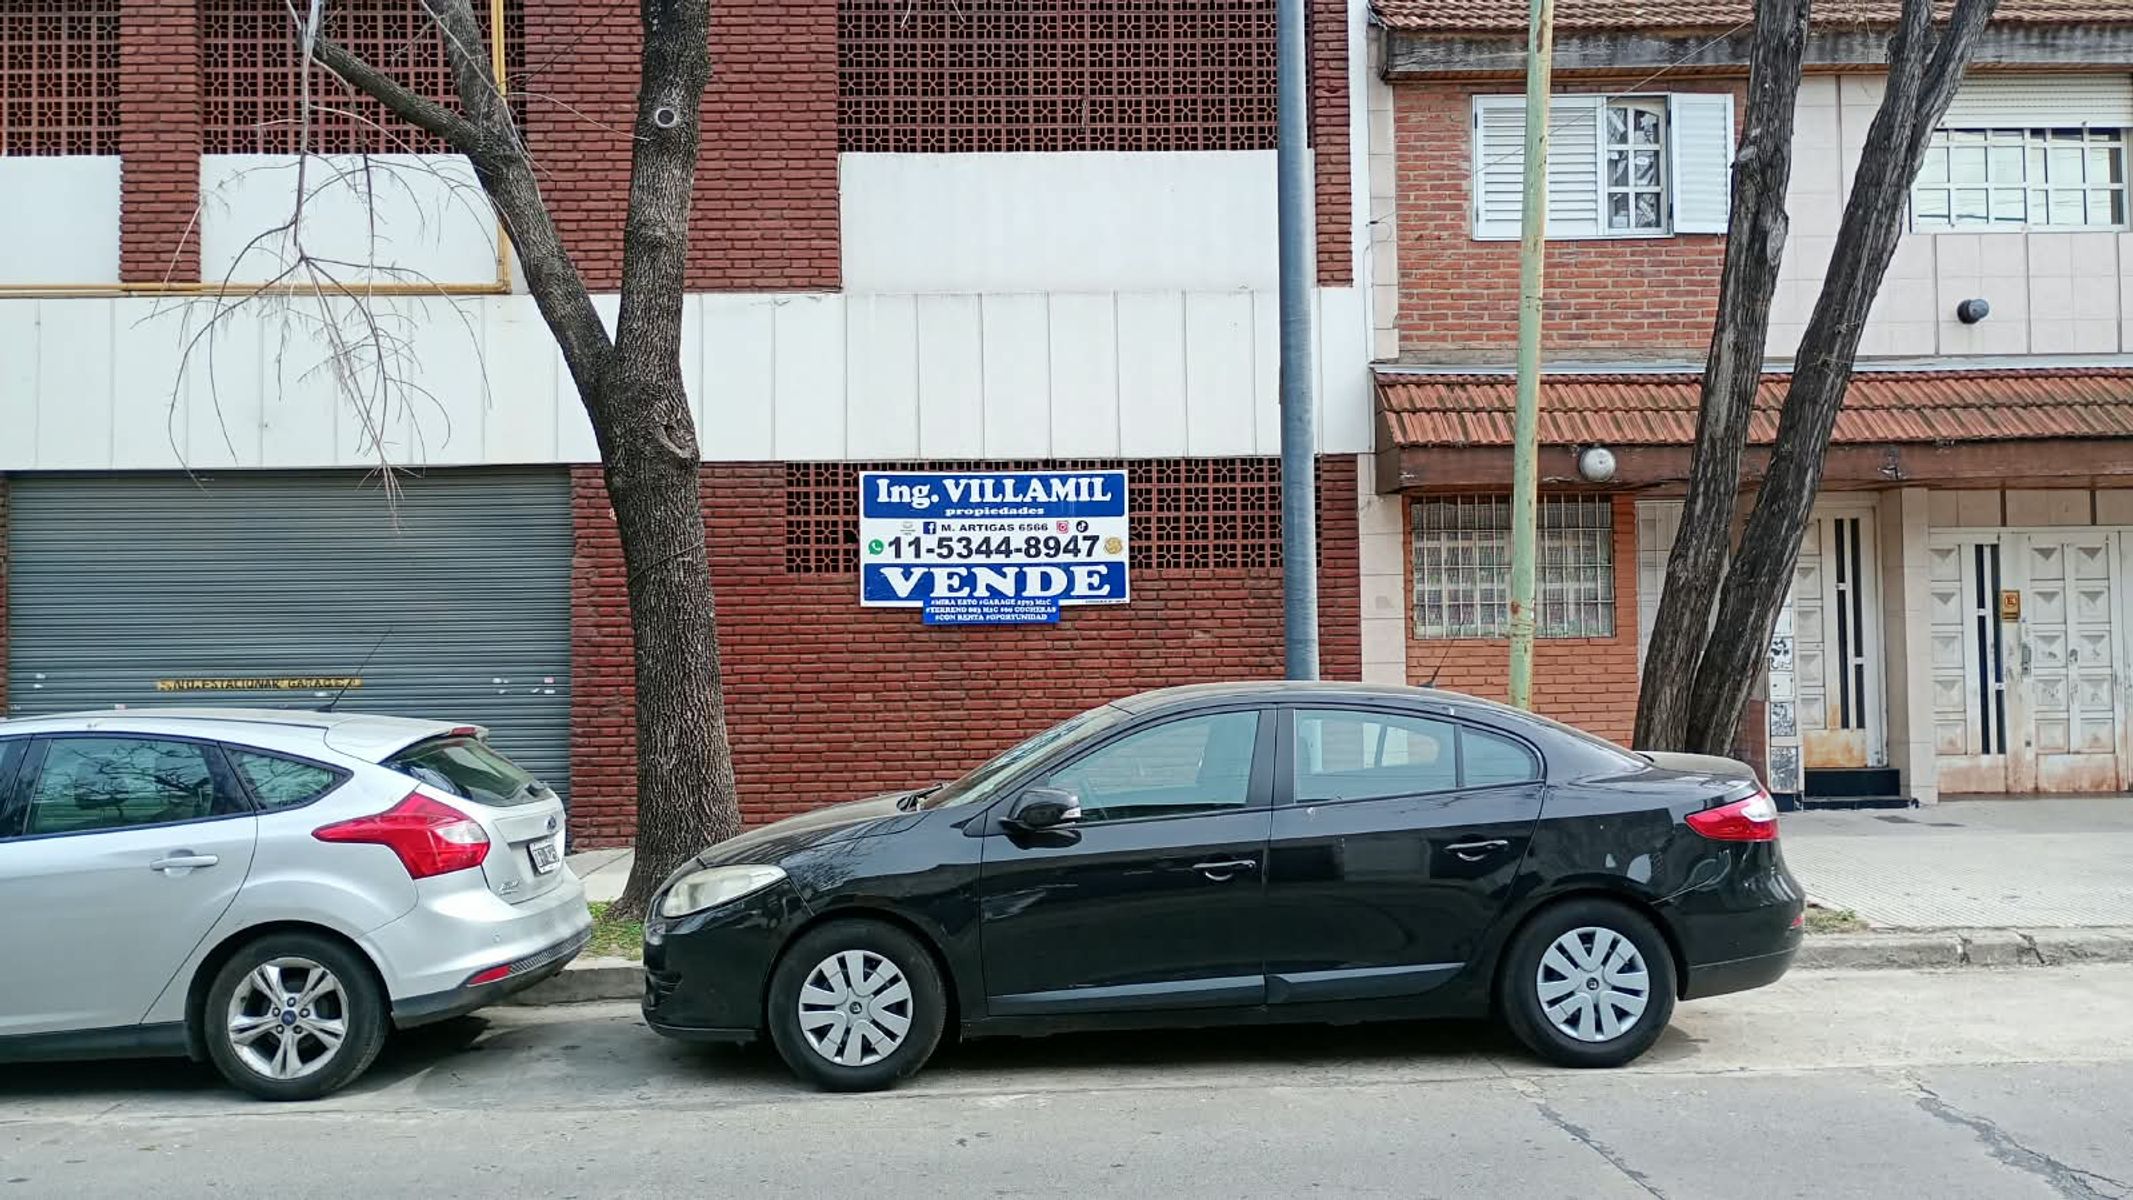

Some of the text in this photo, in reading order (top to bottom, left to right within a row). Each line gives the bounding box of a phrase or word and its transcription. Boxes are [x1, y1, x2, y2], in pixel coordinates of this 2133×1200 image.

[876, 477, 1112, 509] Ing. VILLAMIL
[945, 507, 1044, 516] propiedades
[941, 524, 955, 532] M.
[959, 524, 1015, 532] ARTIGAS
[888, 535, 1100, 559] 11-5344-8947
[879, 564, 1111, 598] VENDE
